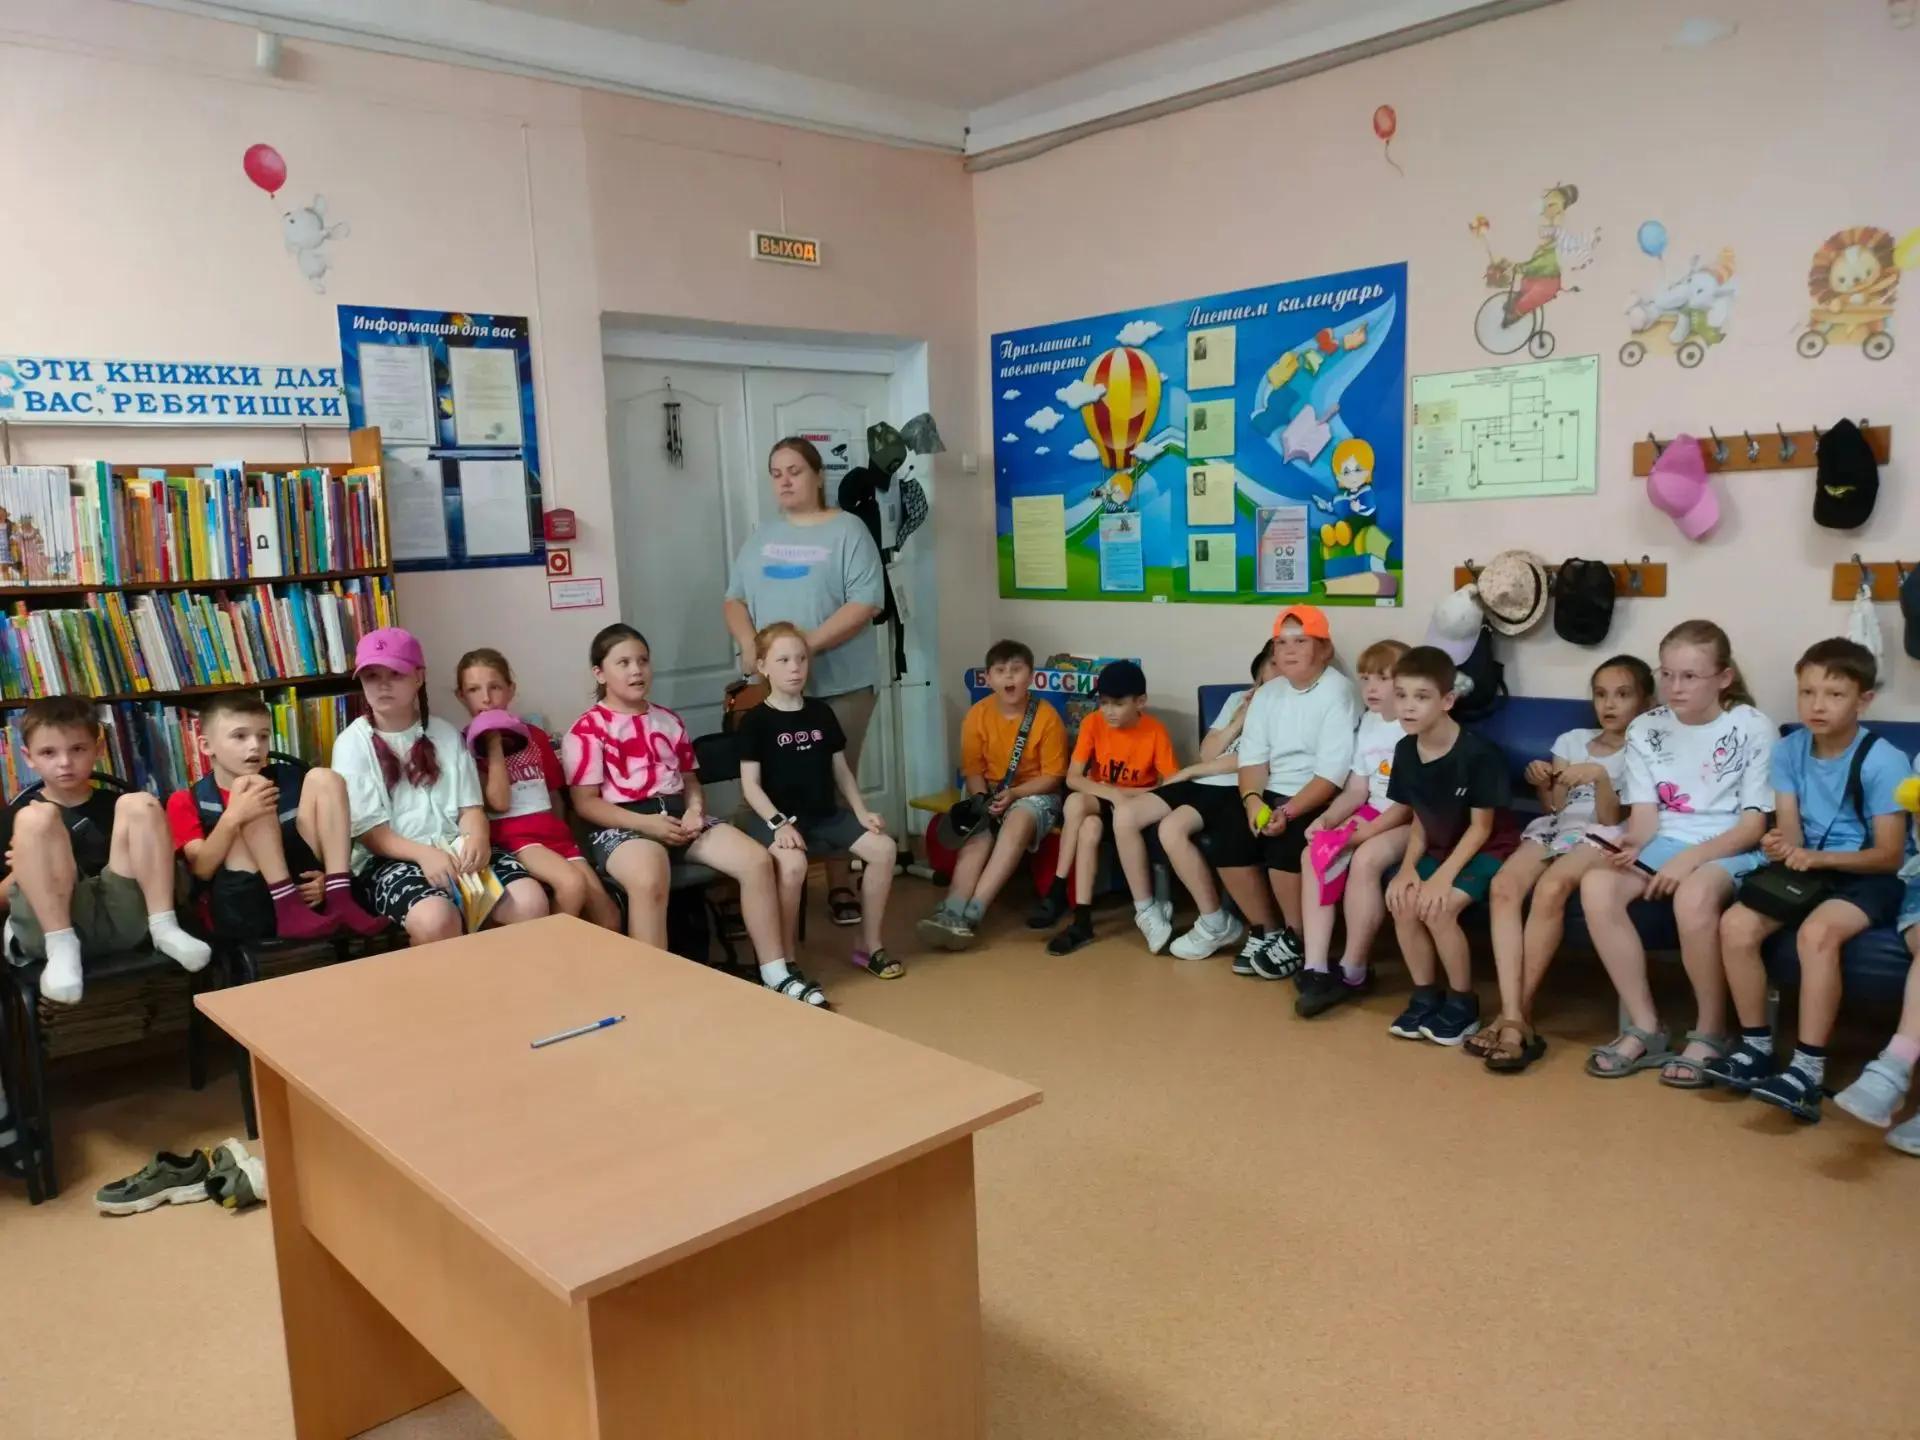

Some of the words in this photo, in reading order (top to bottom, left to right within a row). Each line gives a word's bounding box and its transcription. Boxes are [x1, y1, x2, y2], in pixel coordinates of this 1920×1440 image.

[760, 238, 815, 262] ВЫХОД
[1185, 302, 1269, 327] Листаем
[1277, 284, 1384, 312] календарь
[353, 315, 458, 335] Информация
[461, 323, 489, 337] для
[492, 327, 517, 339] вас
[1000, 334, 1091, 361] Приглашаем
[16, 359, 94, 381] ЭТИ
[104, 362, 263, 386] КНИЖКИ
[275, 367, 339, 389] ДЛЯ
[1000, 356, 1087, 378] посмотреть
[23, 391, 104, 414] ВАС,
[111, 393, 342, 416] РЕБЯТИШКИ
[1033, 671, 1100, 693] ОССИ
